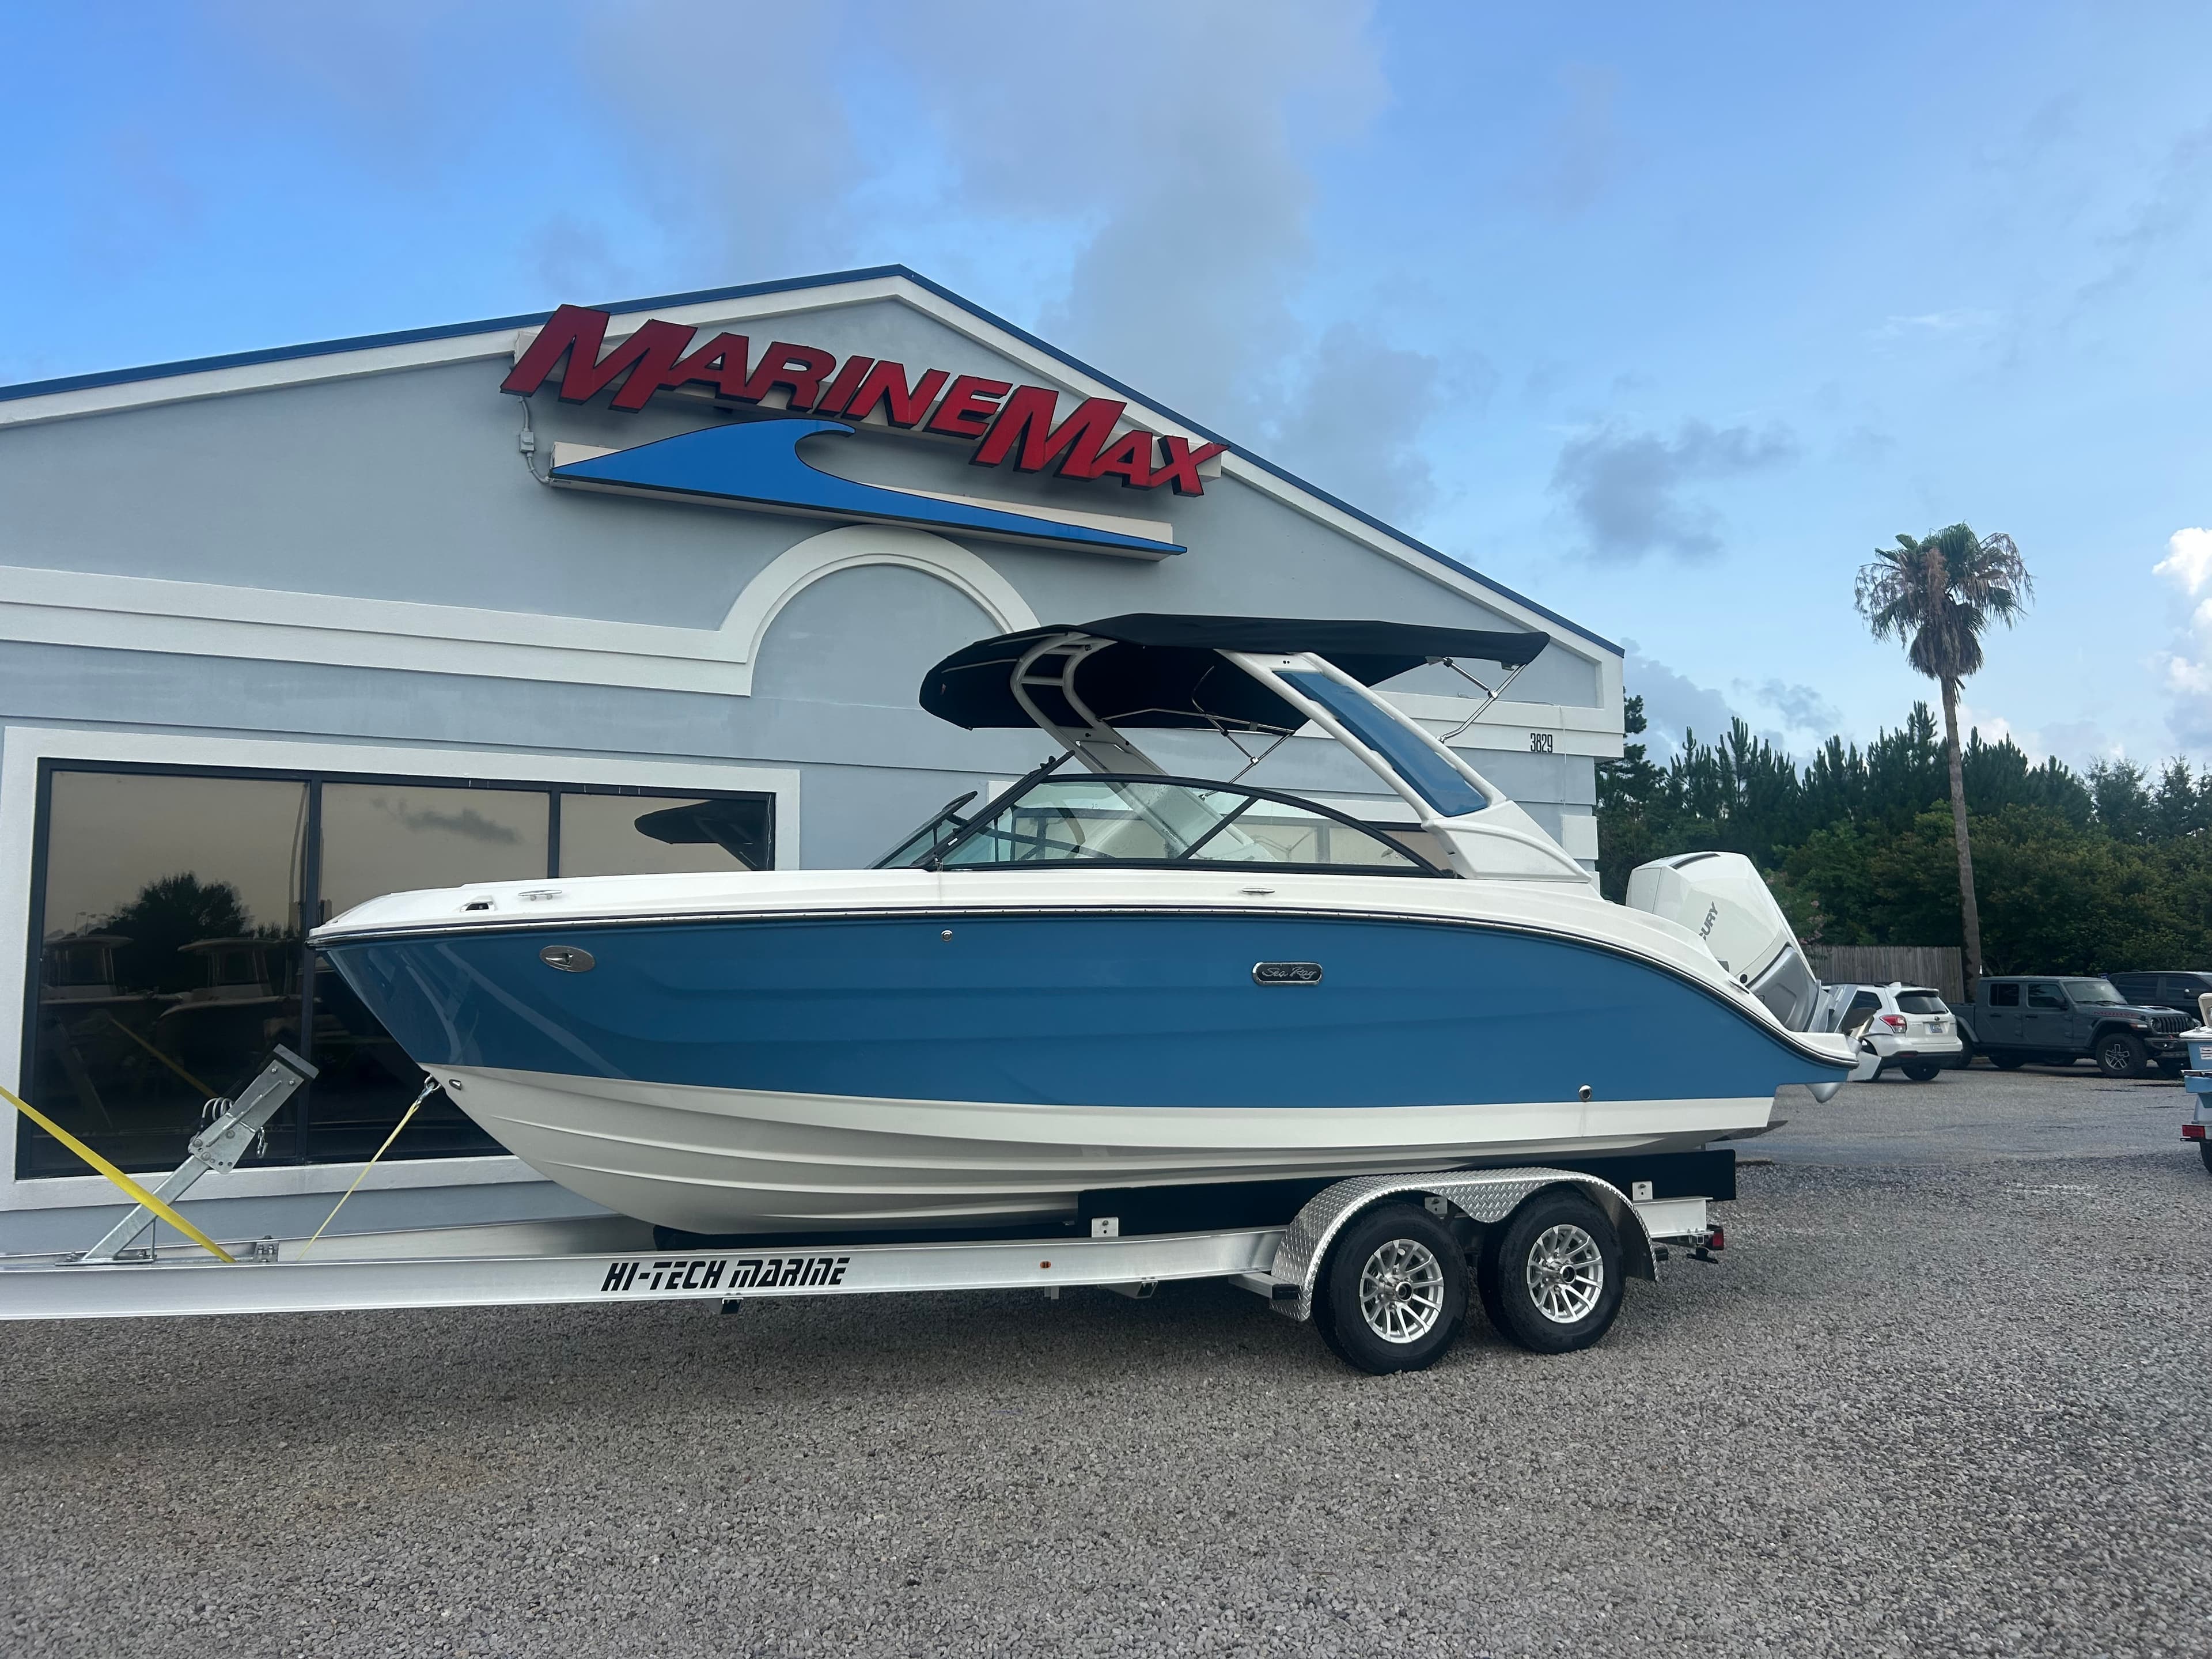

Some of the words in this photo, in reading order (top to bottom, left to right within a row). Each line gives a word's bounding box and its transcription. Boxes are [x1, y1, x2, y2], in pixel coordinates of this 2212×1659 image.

[1530, 733, 1553, 752] 3829
[1262, 967, 1289, 977] Sea
[1289, 966, 1317, 979] Ray
[601, 1260, 727, 1291] HI-TECH
[728, 1257, 851, 1288] MARINE
